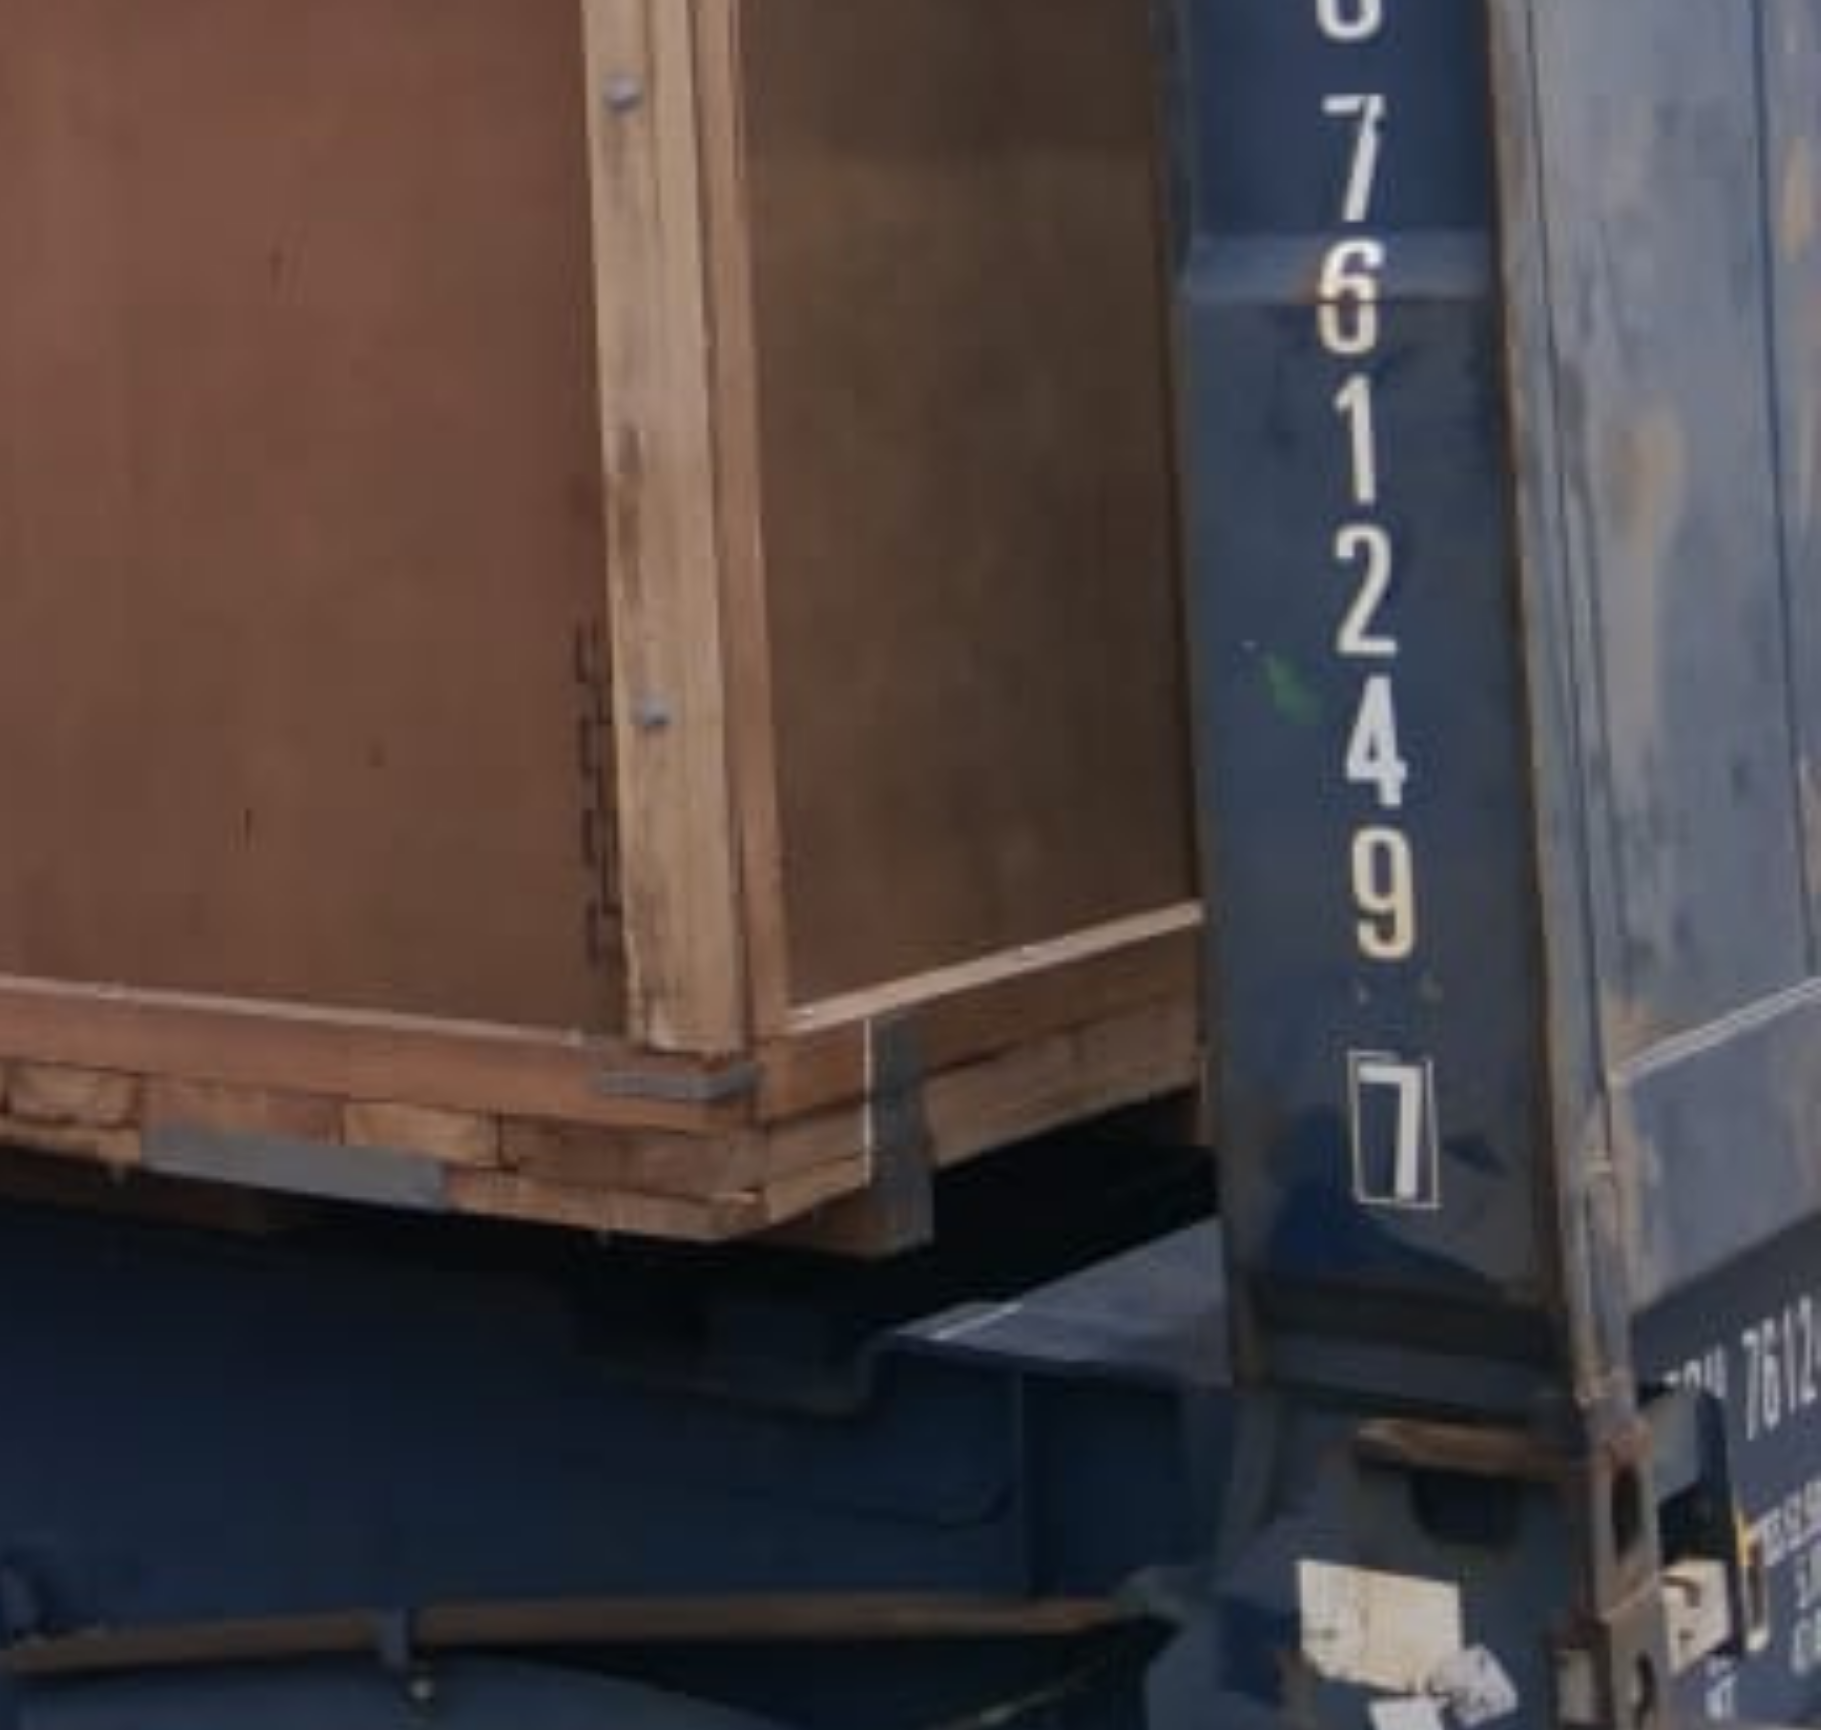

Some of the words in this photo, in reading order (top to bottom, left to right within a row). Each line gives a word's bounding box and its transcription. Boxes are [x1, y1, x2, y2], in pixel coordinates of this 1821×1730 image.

[1317, 93, 1415, 962] 761249
[1355, 1058, 1431, 1206] 7
[1741, 1294, 1821, 1441] 7612
